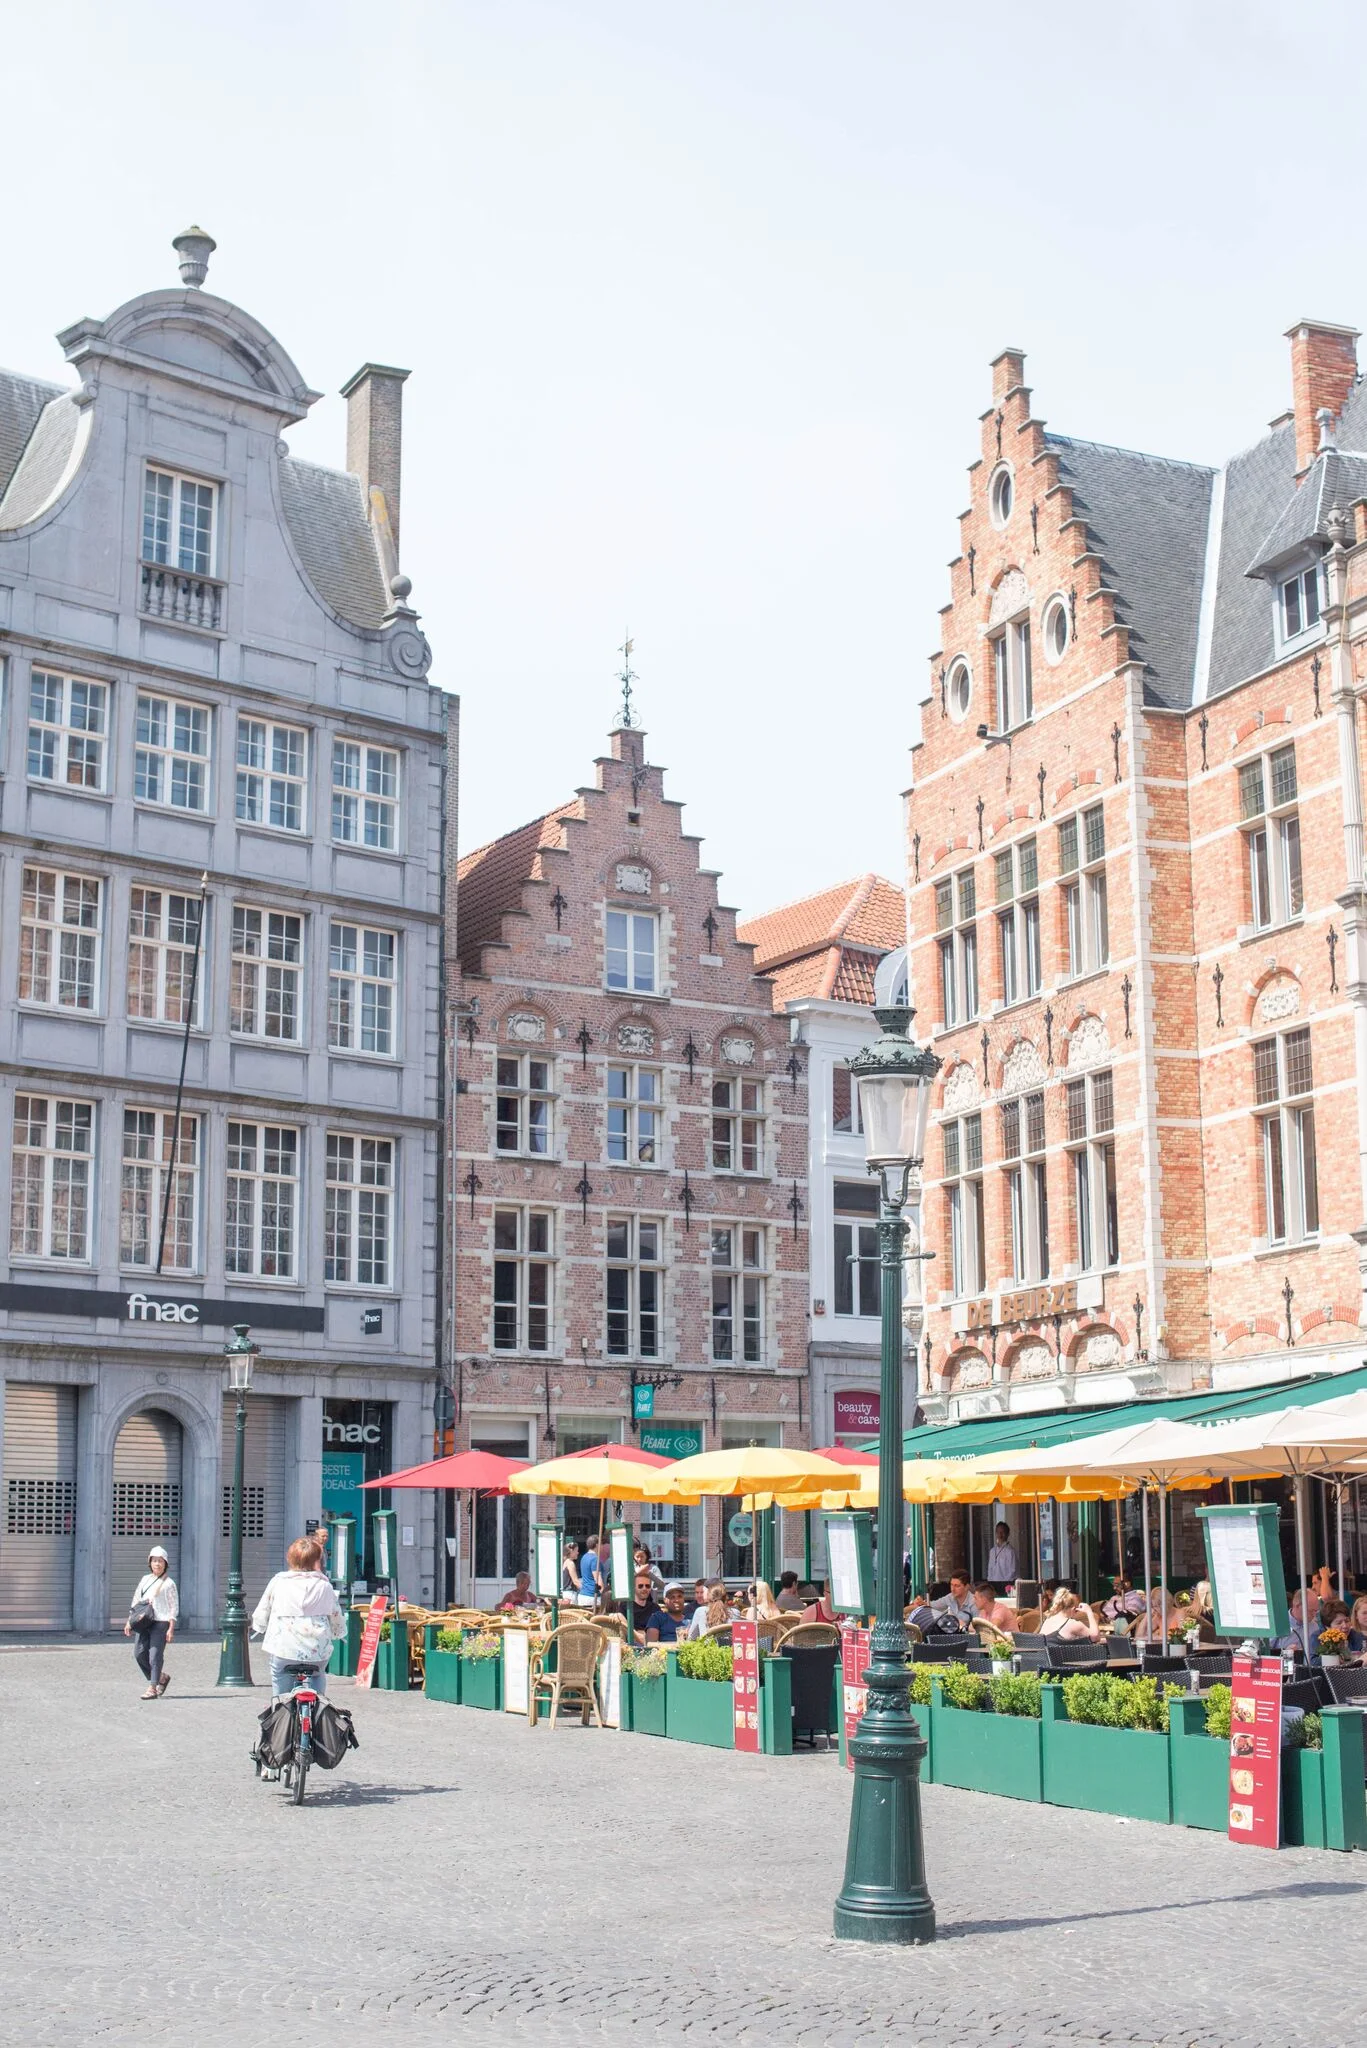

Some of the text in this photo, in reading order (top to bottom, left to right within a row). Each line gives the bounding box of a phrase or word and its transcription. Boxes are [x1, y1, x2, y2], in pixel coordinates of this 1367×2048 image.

[127, 1293, 199, 1324] fnac
[967, 1281, 1078, 1328] DE BEURZE
[364, 1314, 381, 1323] fnac
[837, 1401, 872, 1416] beauty
[848, 1413, 880, 1425] & care
[641, 1435, 672, 1449] PEARLE
